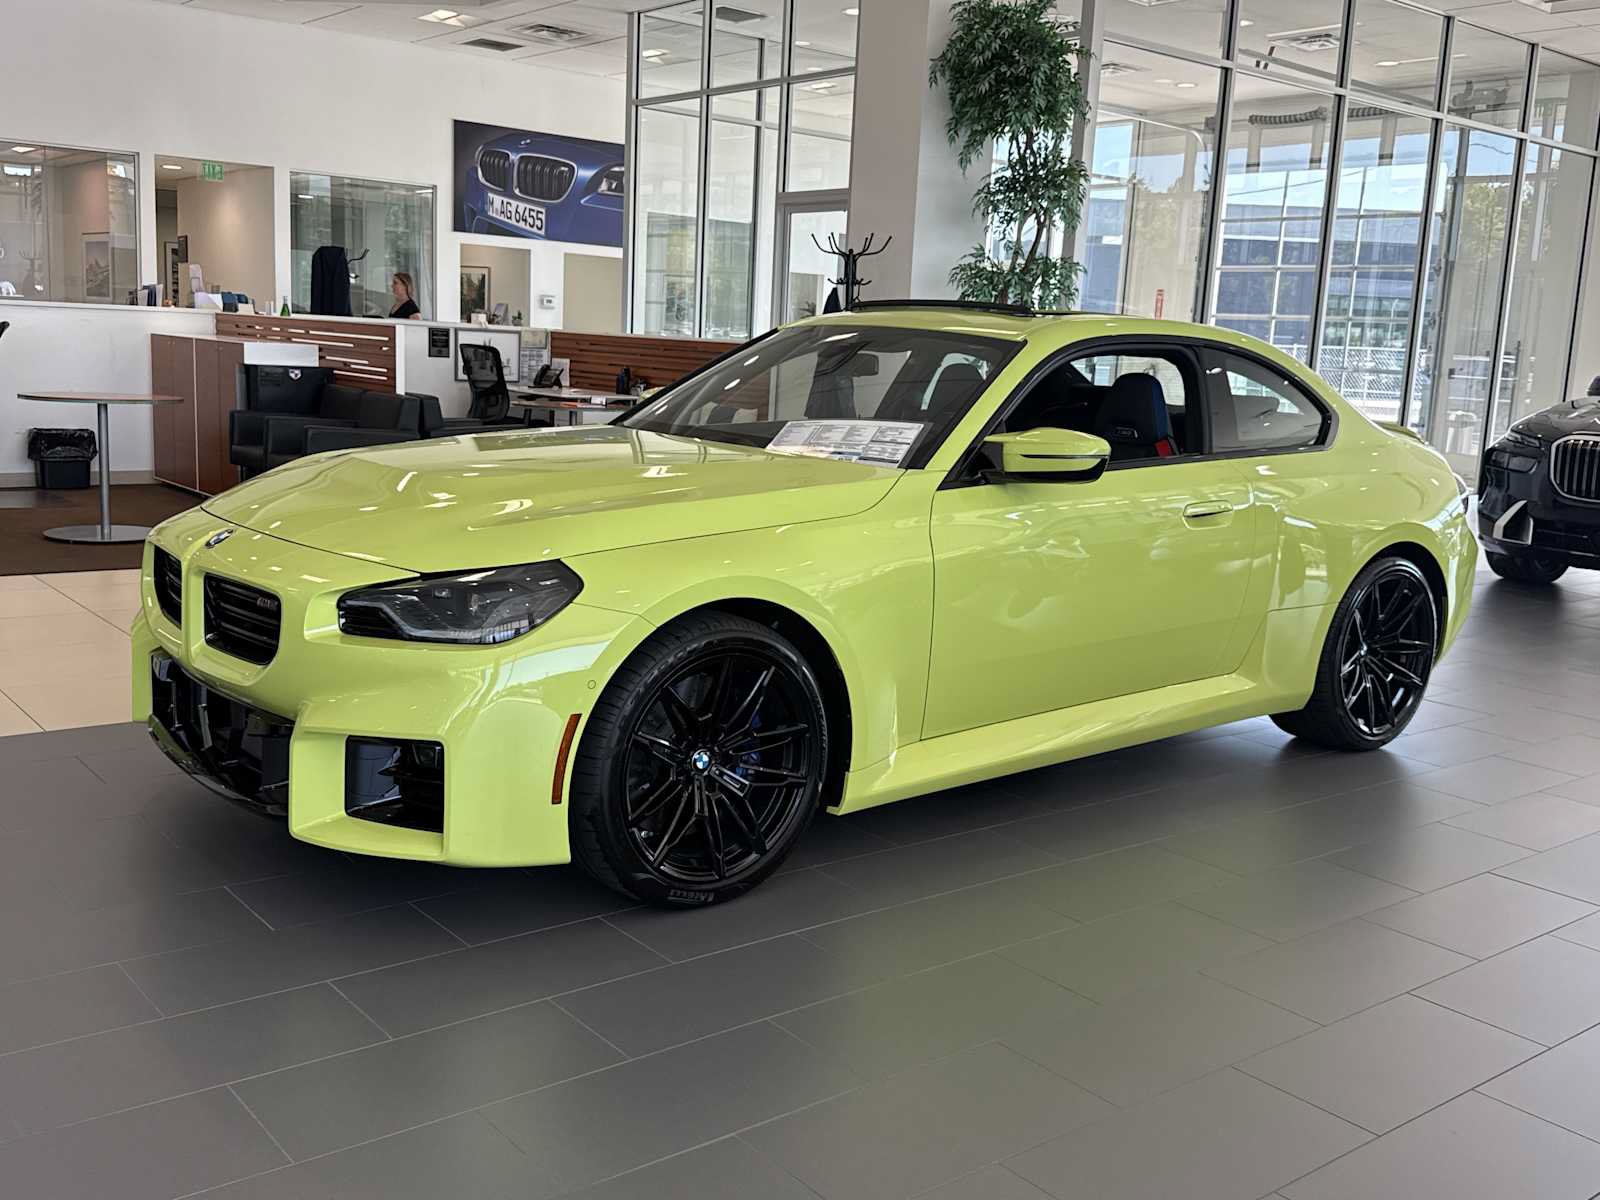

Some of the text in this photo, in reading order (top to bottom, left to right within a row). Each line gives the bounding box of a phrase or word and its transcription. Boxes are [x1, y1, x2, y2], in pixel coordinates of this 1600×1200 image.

[487, 196, 544, 231] M AG 6455
